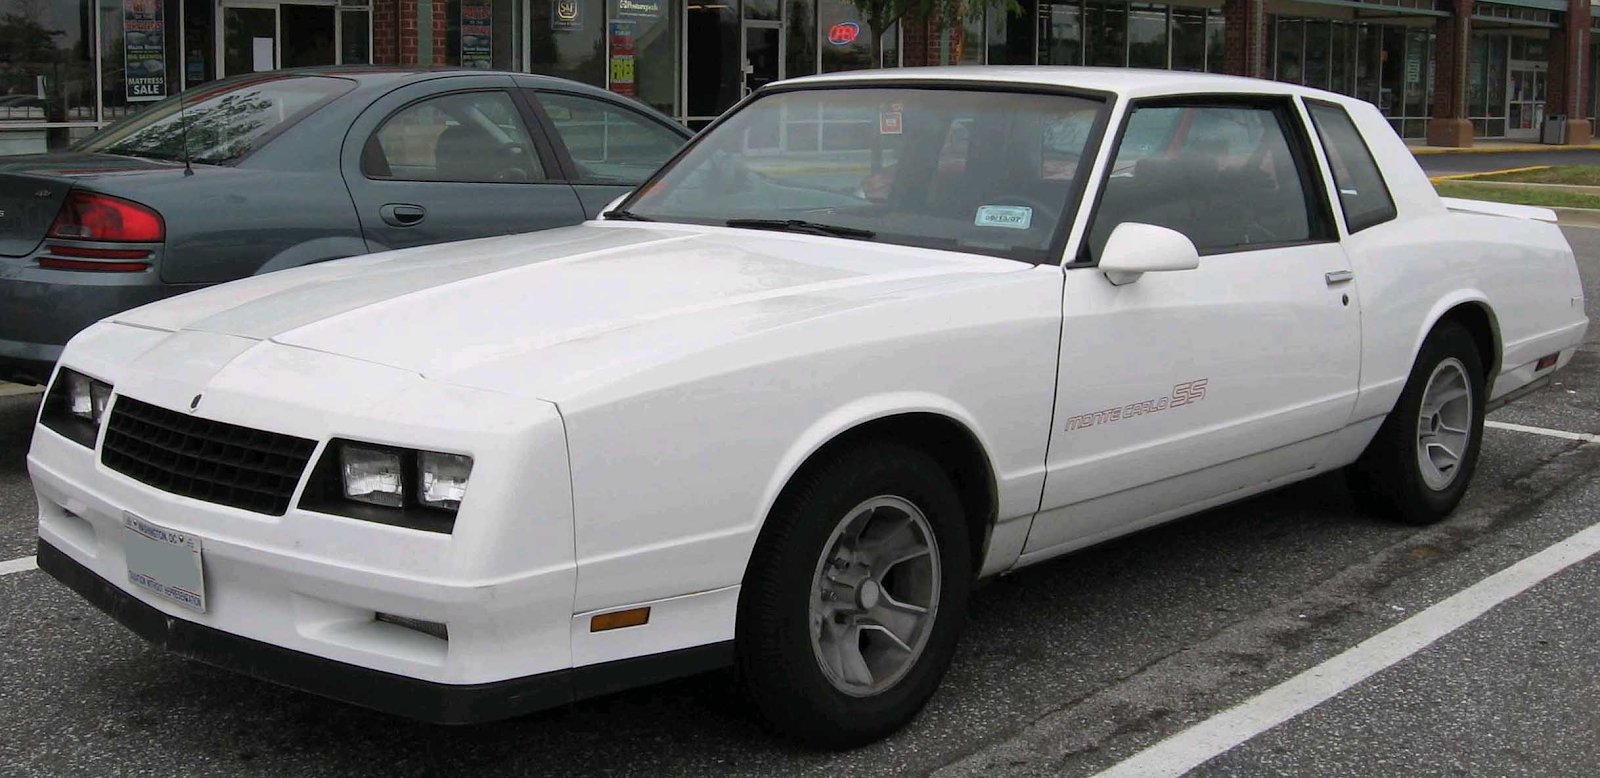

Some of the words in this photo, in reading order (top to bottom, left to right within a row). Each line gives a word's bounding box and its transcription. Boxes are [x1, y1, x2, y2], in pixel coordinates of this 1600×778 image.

[829, 25, 857, 41] OPEN
[610, 58, 634, 80] FREE
[128, 77, 164, 85] MATTRESS
[133, 85, 160, 95] SALE
[1064, 407, 1122, 432] MONTE
[1122, 396, 1169, 419] CARLO
[1170, 378, 1209, 408] SS
